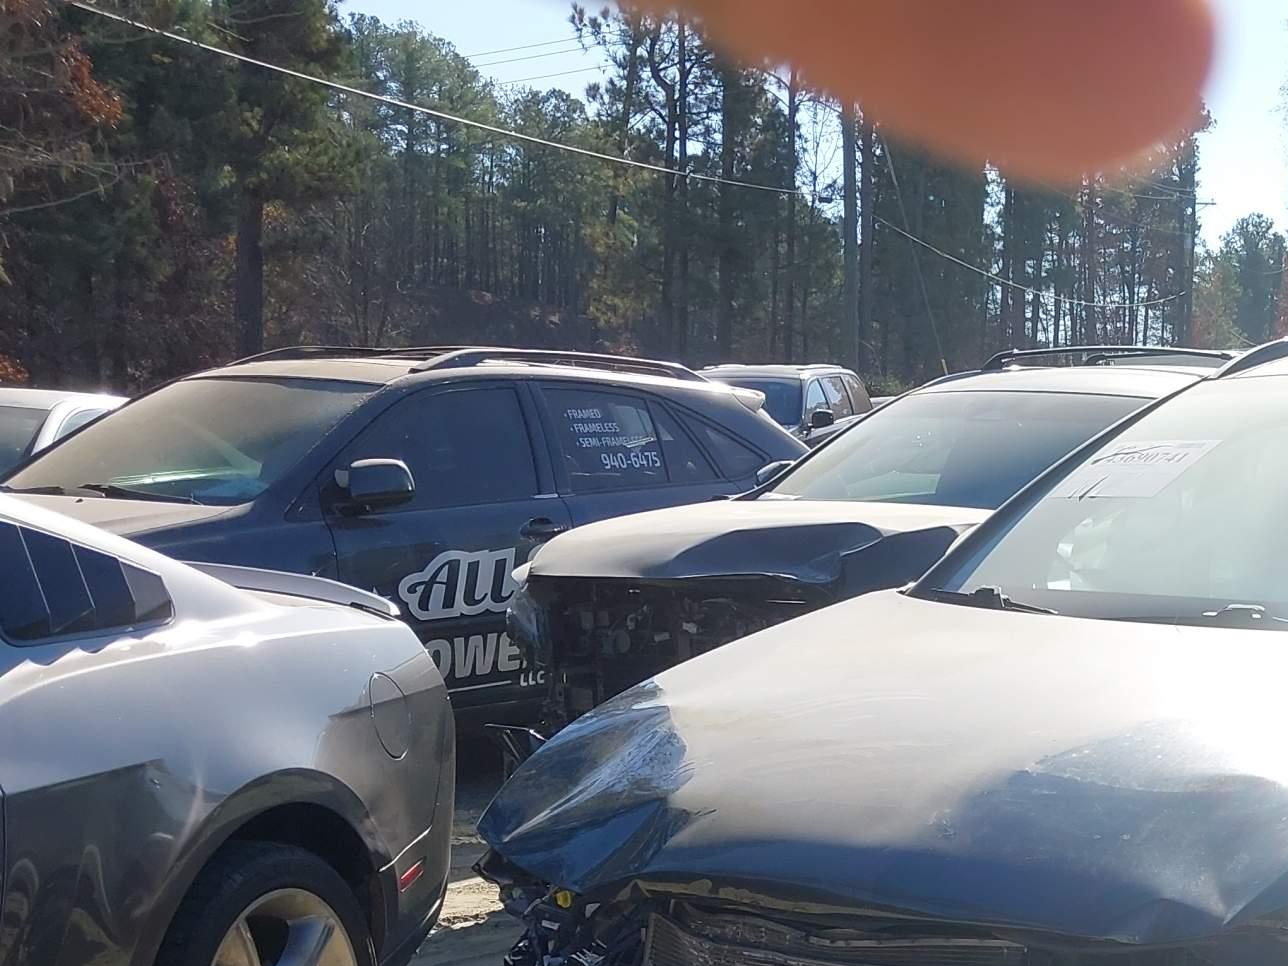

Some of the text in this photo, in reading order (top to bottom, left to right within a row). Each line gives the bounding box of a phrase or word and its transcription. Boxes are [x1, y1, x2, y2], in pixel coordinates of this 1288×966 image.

[567, 409, 601, 419] FRAMED
[573, 422, 620, 433] FRAMELESS
[601, 451, 660, 470] 940-6475
[519, 670, 545, 687] LLC
